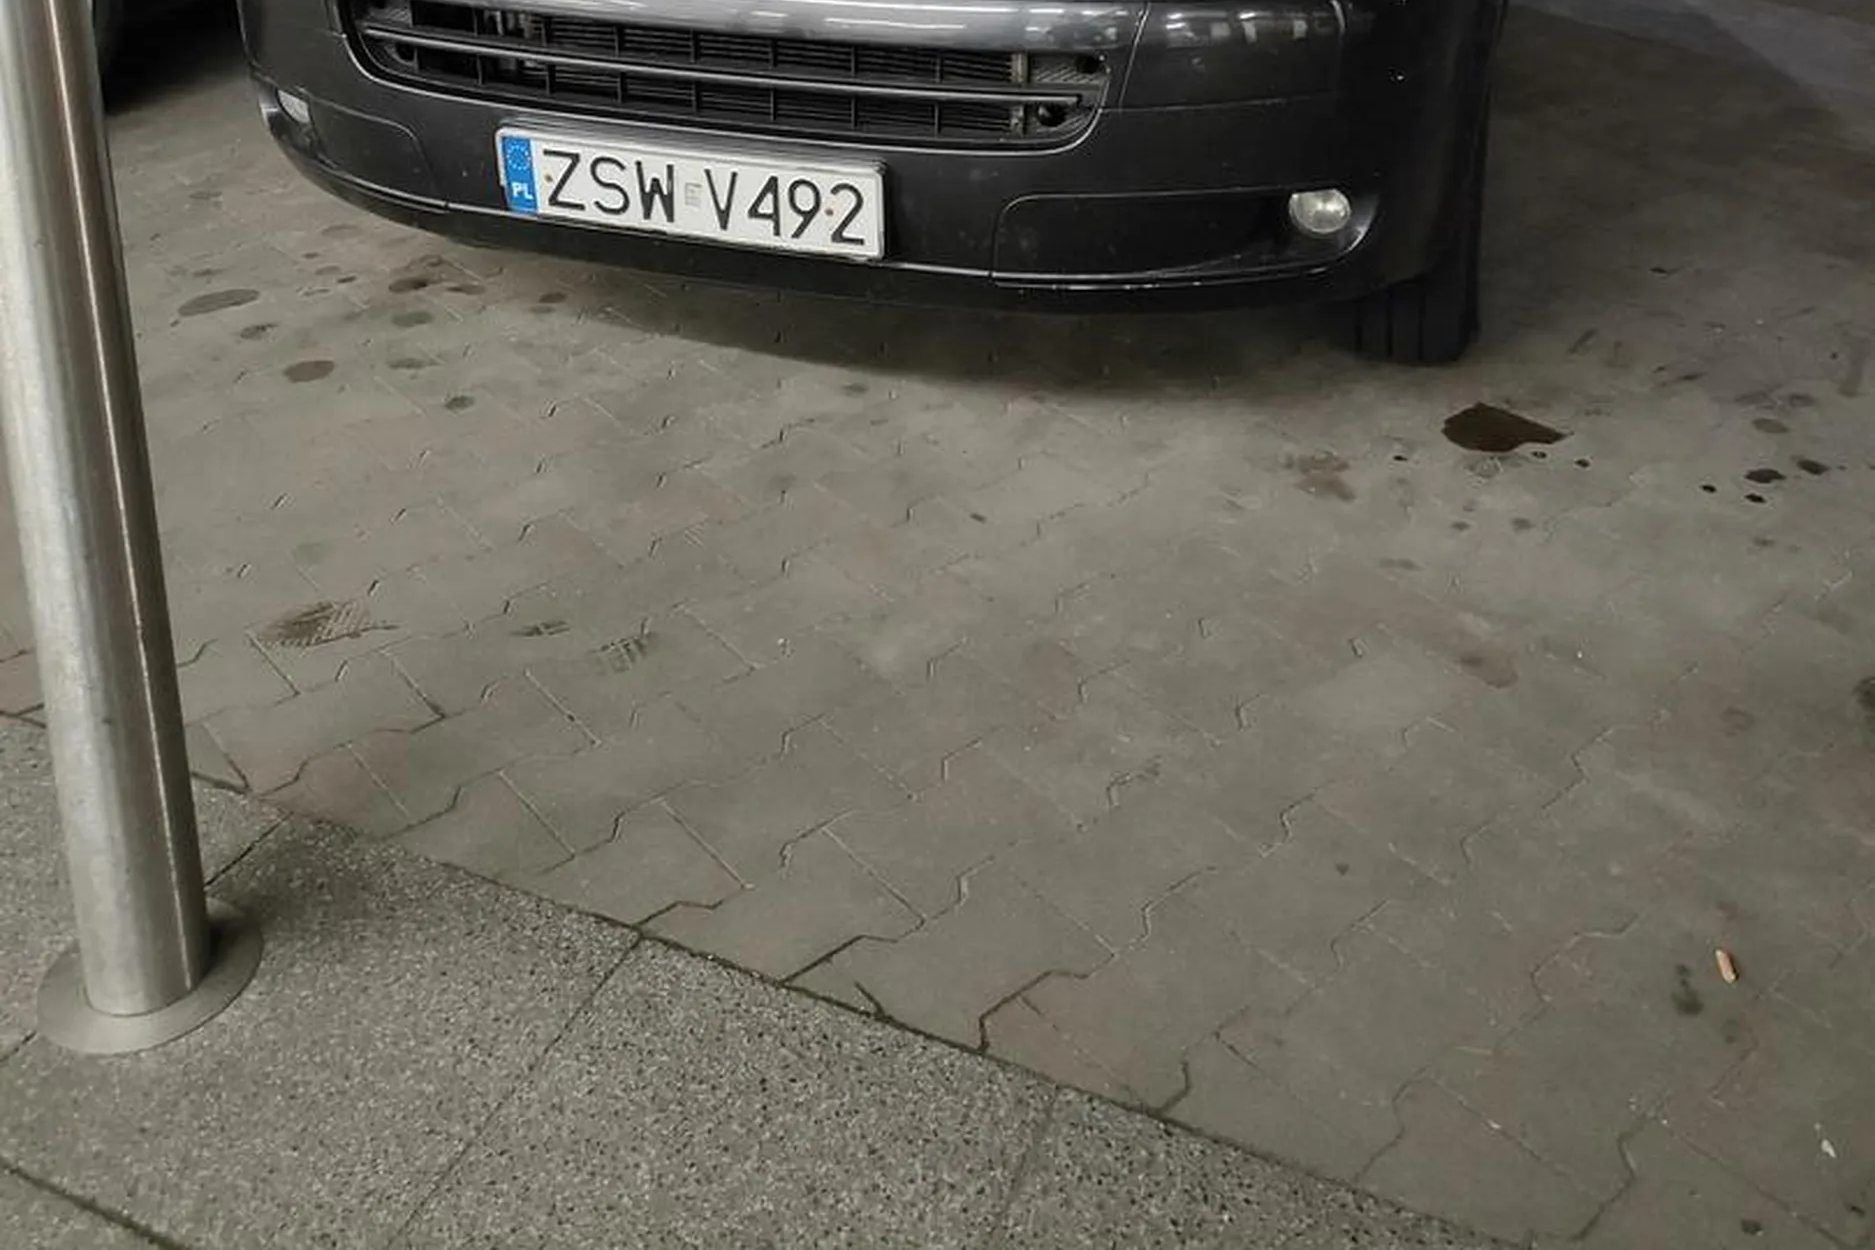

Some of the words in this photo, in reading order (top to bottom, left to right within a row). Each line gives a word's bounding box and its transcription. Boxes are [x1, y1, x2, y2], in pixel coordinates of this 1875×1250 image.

[511, 181, 534, 201] PL
[542, 149, 675, 223] ZSW
[704, 168, 866, 246] V492
